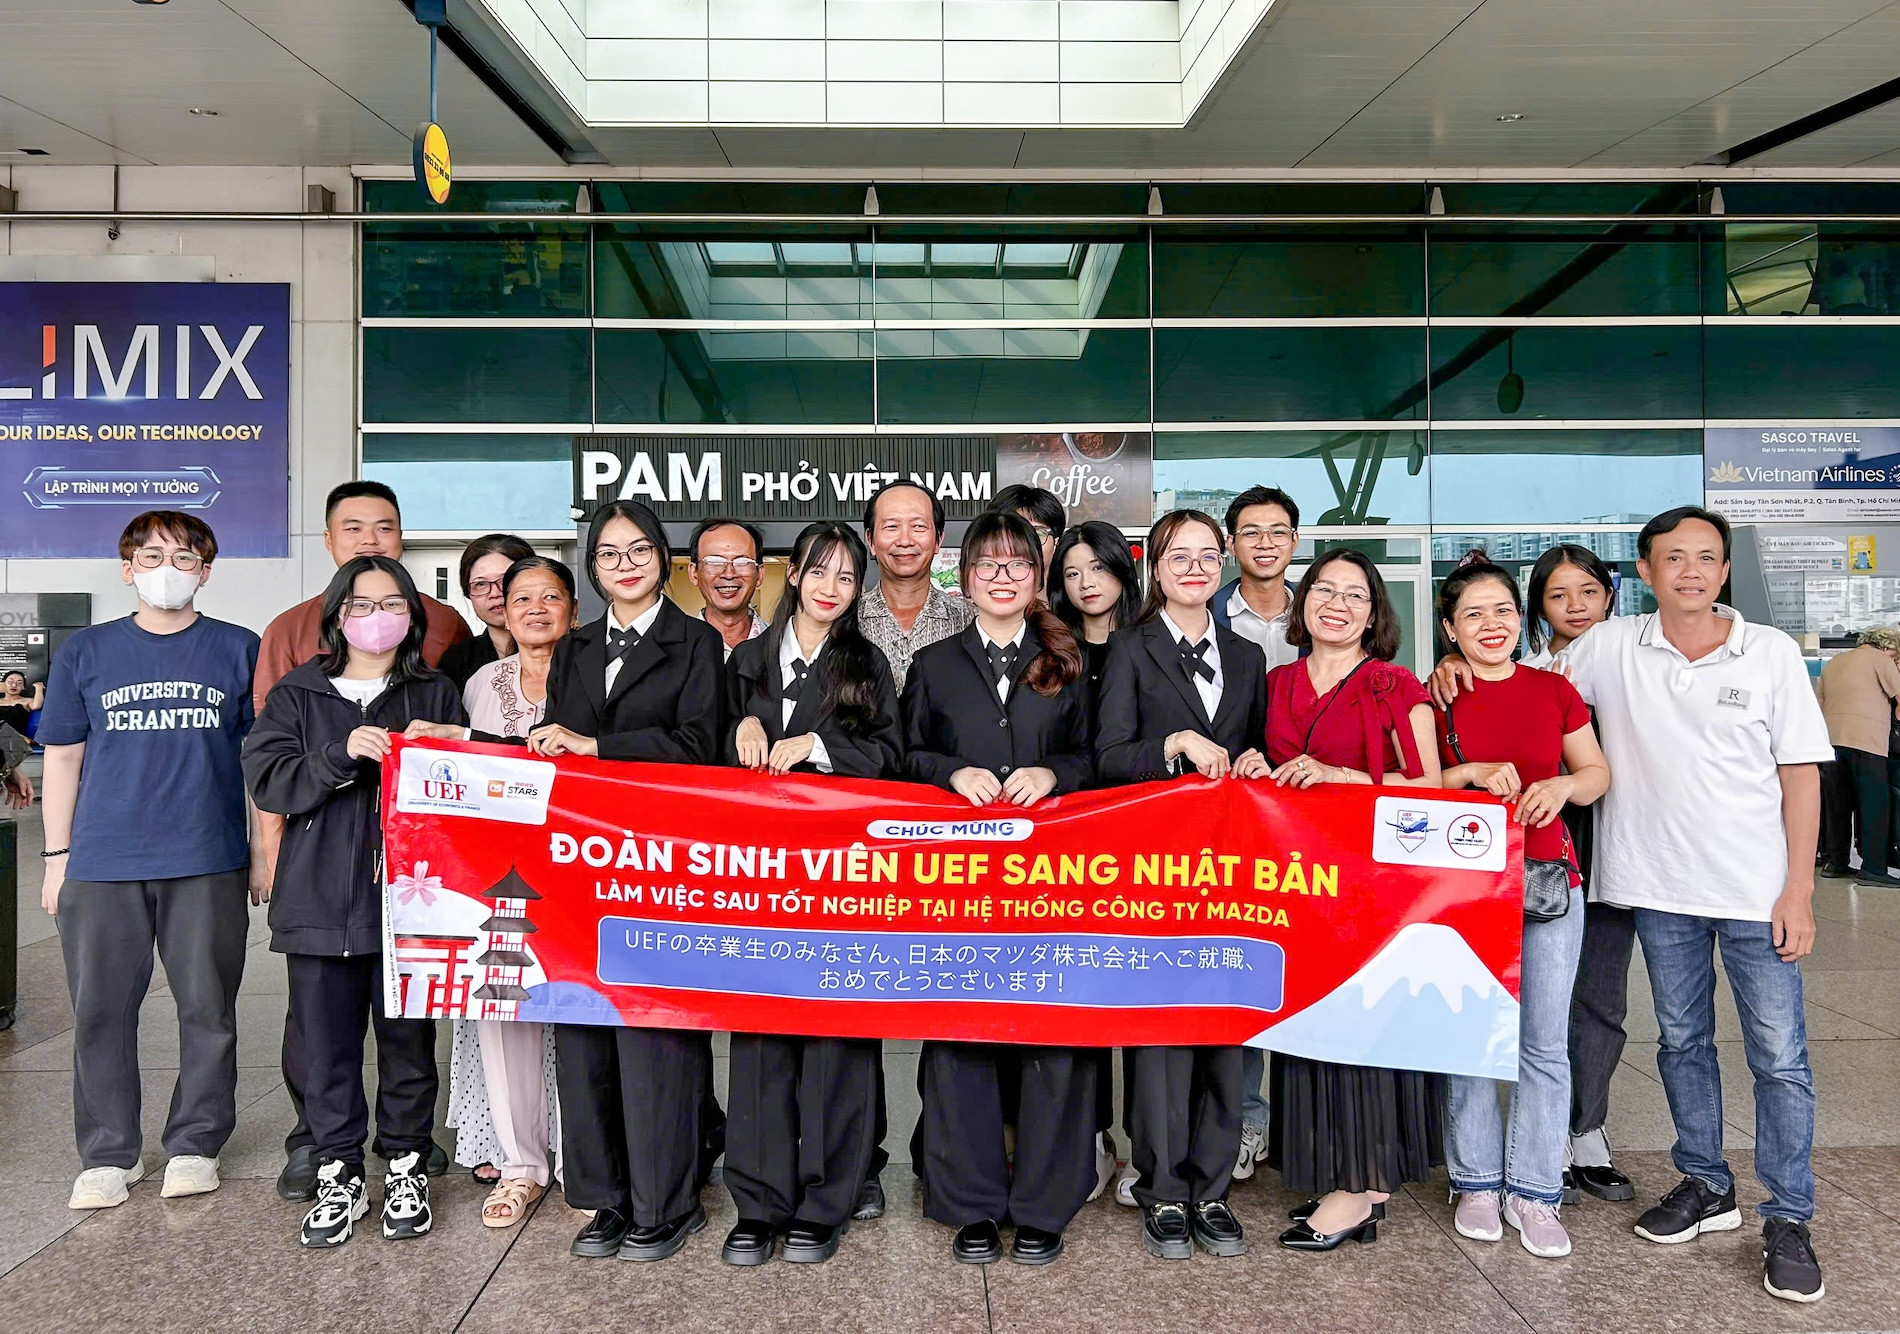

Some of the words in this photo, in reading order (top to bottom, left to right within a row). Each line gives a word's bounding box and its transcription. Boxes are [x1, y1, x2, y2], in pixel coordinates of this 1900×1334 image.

[37, 425, 93, 442] IDEAS,
[98, 425, 136, 441] OUR
[140, 425, 263, 441] TECHNOLOGY
[1761, 432, 1807, 443] SASCO
[1810, 432, 1860, 443] TRAVEL
[582, 451, 722, 501] PAM
[742, 460, 819, 501] PHỞ
[910, 472, 991, 500] NAM
[1745, 466, 1818, 482] Vietnam
[1820, 466, 1885, 482] Airlines
[45, 479, 69, 494] LẬP
[71, 479, 109, 493] TRÌNH
[112, 482, 138, 497] MỌI
[141, 478, 150, 493] Ý
[152, 478, 200, 493] TƯỞNG
[1032, 464, 1117, 507] Coffee
[101, 681, 202, 711] UNIVERSITY
[207, 688, 225, 706] OF
[1729, 689, 1739, 700] R
[106, 708, 220, 731] SCRANTON
[423, 780, 468, 801] UEF
[508, 786, 538, 796] STARS
[886, 822, 944, 837] CHÚC
[951, 820, 1014, 836] MỪNG
[550, 830, 673, 873] ĐOÀN
[687, 844, 787, 879] SINH
[802, 842, 898, 883] VIÊN
[913, 853, 988, 885] UEF
[1001, 853, 1120, 885] SANG
[1133, 847, 1241, 895] NHẬT
[1254, 850, 1339, 898] BẢN
[595, 879, 642, 904] LÀM
[650, 887, 705, 912] VIỆC
[712, 889, 759, 912] SAU
[768, 888, 816, 915] TỐT
[822, 894, 912, 922] NGHIỆP
[920, 899, 956, 923] TẠI
[964, 895, 992, 922] HỆ
[1000, 893, 1084, 919] THỐNG
[1092, 895, 1165, 921] CÔNG
[1173, 902, 1199, 920] TY
[1206, 902, 1290, 928] MAZDA
[625, 929, 1255, 972] UEFの卒業生のみなさん、日本のマツダ株式会社へご就職、
